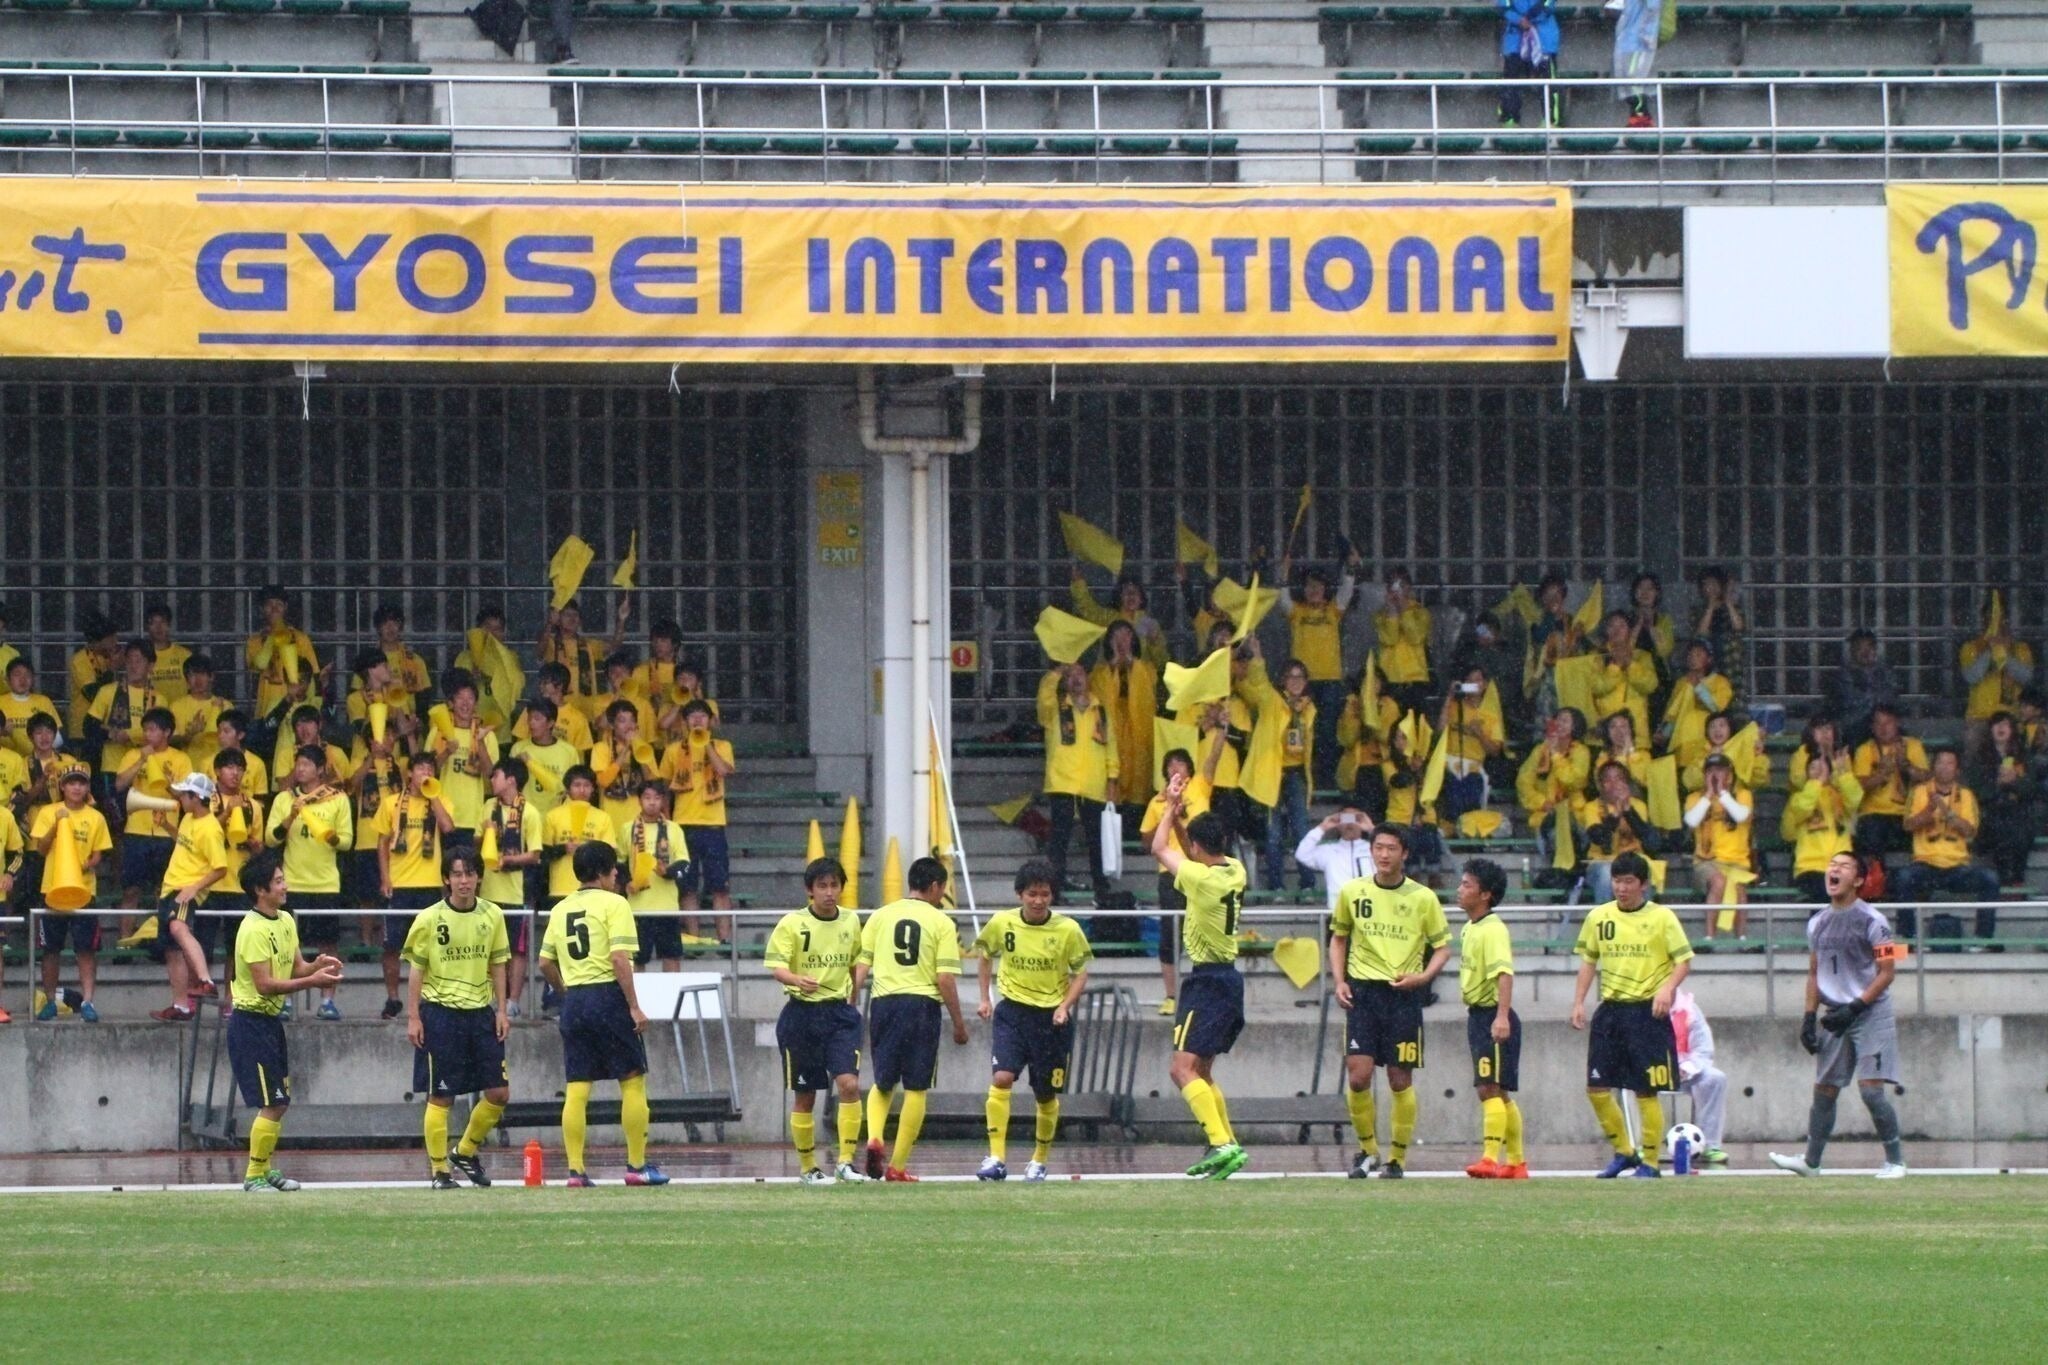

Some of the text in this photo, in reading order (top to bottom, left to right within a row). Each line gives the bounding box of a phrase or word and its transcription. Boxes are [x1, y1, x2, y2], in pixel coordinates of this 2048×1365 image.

[197, 231, 1555, 315] GYOSEI INTERNATIONAL
[822, 547, 858, 562] EXIT
[1352, 898, 1373, 919] 16
[437, 924, 450, 946] 3
[566, 910, 590, 961] 5
[800, 930, 811, 952] 7
[1596, 920, 1616, 941] 10
[893, 918, 922, 967] 9
[1004, 931, 1016, 953] 8
[1830, 954, 1838, 975] 1
[1396, 1041, 1417, 1063] 16
[1872, 1051, 1883, 1071] 1
[1052, 1067, 1064, 1088] 8
[1478, 1056, 1491, 1078] 6
[1646, 1064, 1668, 1087] 10
